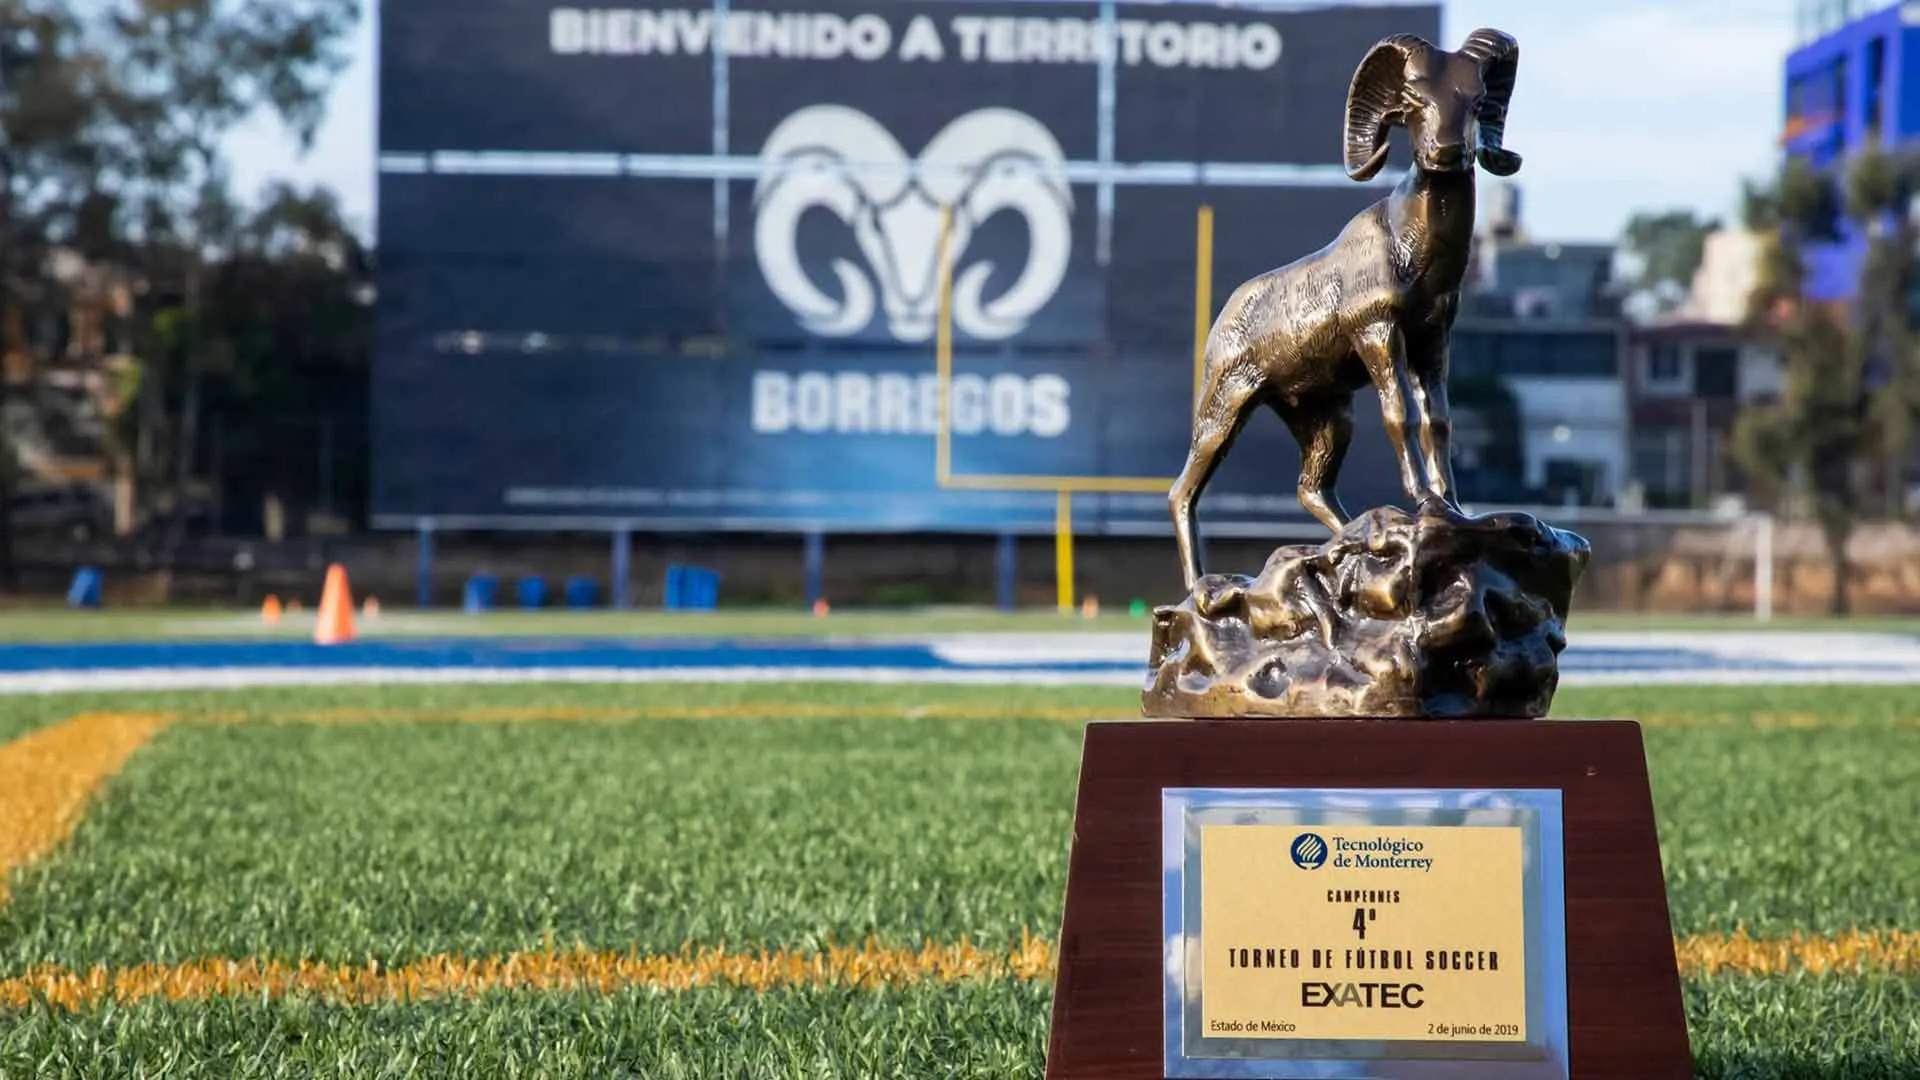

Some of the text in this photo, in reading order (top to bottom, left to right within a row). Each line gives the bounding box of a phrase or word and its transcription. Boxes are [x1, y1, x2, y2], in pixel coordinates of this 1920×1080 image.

[550, 8, 1282, 70] BIENVENIDO A TERRITORIO
[753, 371, 1070, 437] BORREGOS
[1332, 837, 1424, 855] Tecnológico
[1333, 854, 1433, 872] de Monterrey
[1327, 890, 1400, 903] CAMPEONES
[1229, 947, 1498, 970] TORNEO DE FÚTBOL SOCCER
[1301, 982, 1424, 1008] EXATEC
[1211, 1019, 1296, 1032] Estado de México
[1427, 1023, 1519, 1037] 2 de junio de 2019
